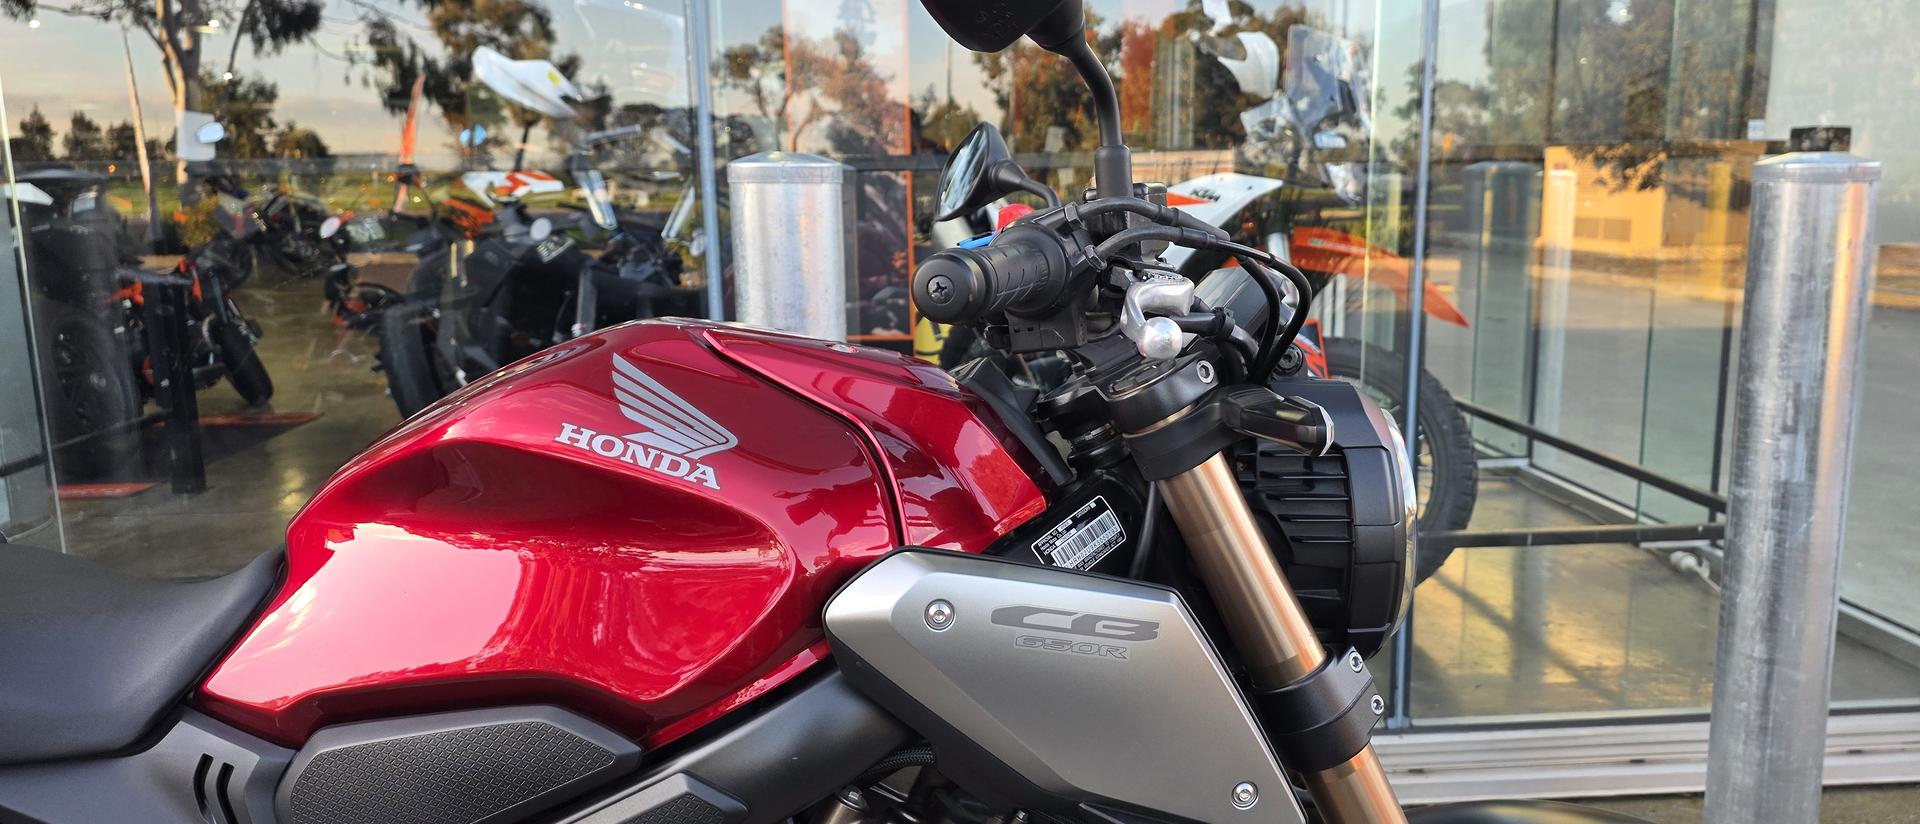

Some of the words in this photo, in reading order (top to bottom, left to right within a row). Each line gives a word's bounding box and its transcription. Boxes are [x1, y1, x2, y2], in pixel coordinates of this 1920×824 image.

[554, 422, 721, 490] HONDA
[991, 606, 1160, 642] CB
[1016, 635, 1128, 660] 650R
